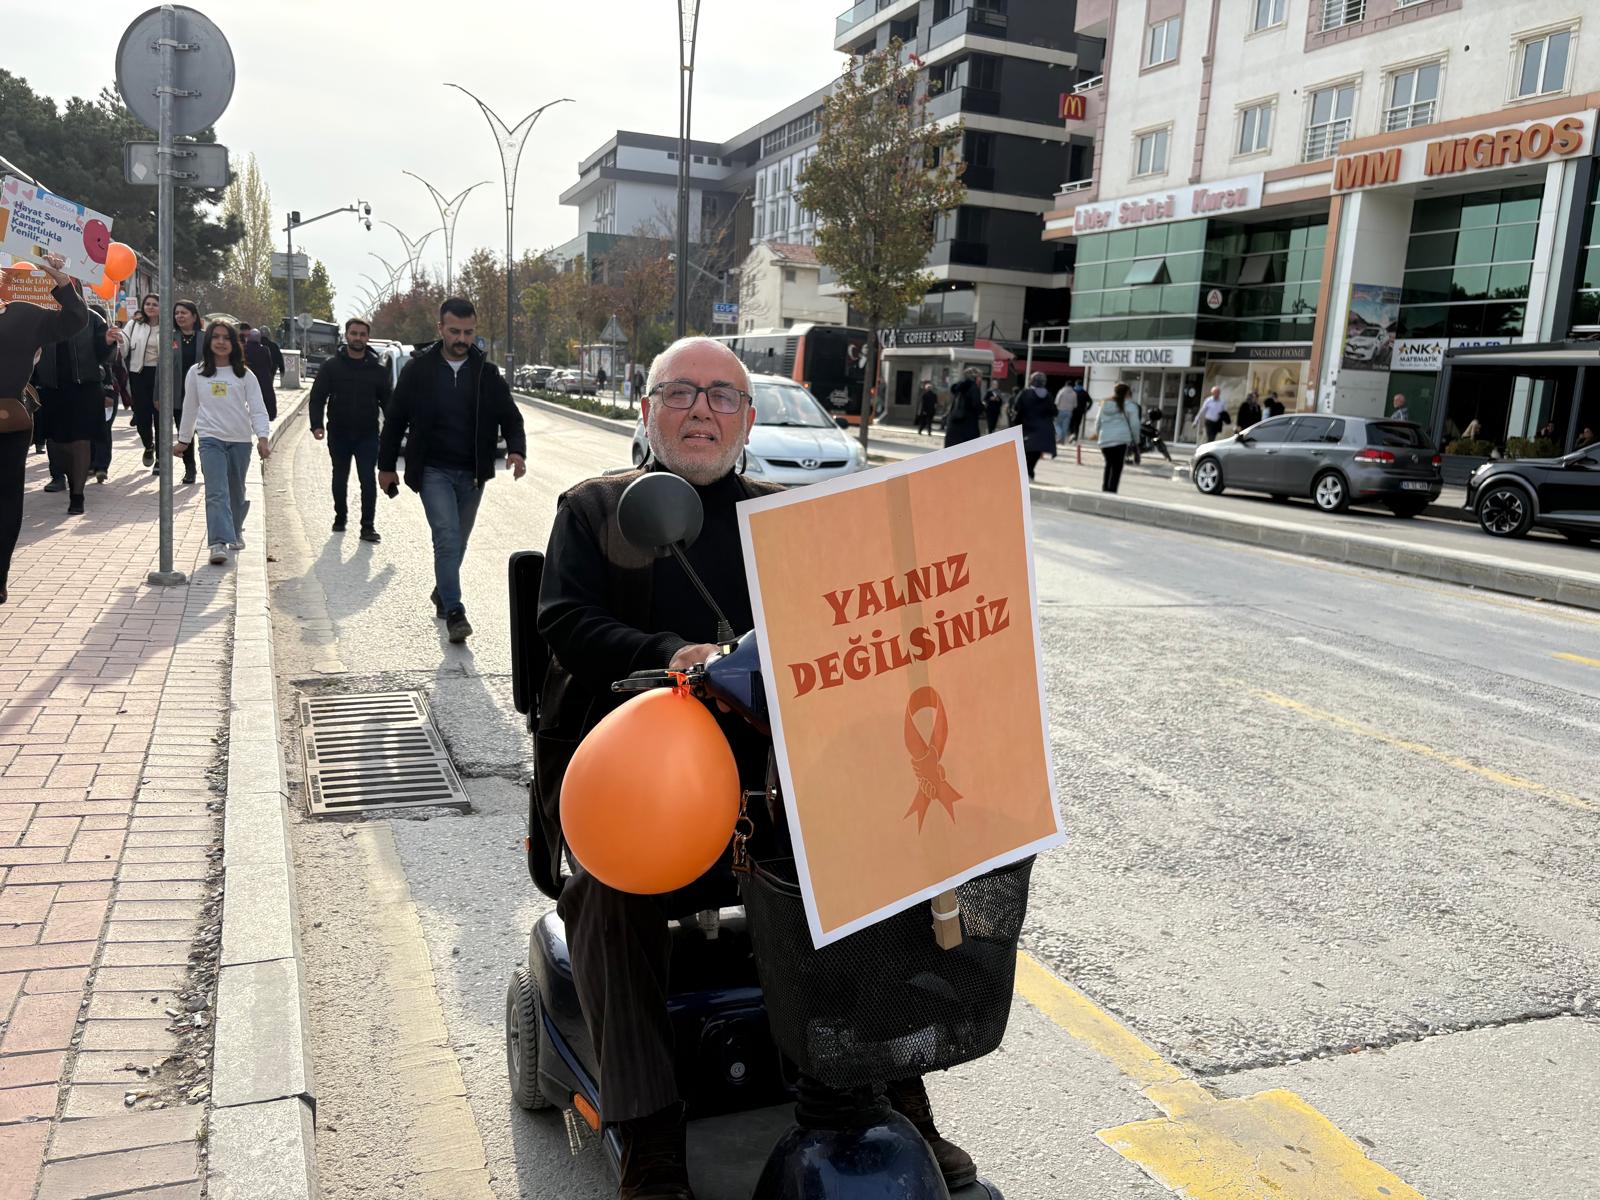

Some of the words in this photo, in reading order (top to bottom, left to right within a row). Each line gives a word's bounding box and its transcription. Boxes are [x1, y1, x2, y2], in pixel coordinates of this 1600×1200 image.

[1333, 148, 1402, 190] MM
[13, 209, 45, 226] Kanser
[14, 201, 43, 217] Hayat
[1075, 207, 1112, 231] Lider
[1119, 195, 1176, 224] Sürücü
[1192, 187, 1249, 215] Kursu
[11, 217, 62, 242] Kararlılıkla
[1082, 349, 1129, 364] ENGLISH
[1134, 349, 1173, 364] HOME
[1250, 349, 1277, 358] ENGLISH
[1279, 349, 1305, 357] HOME
[1399, 341, 1441, 355] ANKA
[821, 552, 970, 626] YALNIZ
[788, 595, 1010, 699] DEĞİLSİNİZ
